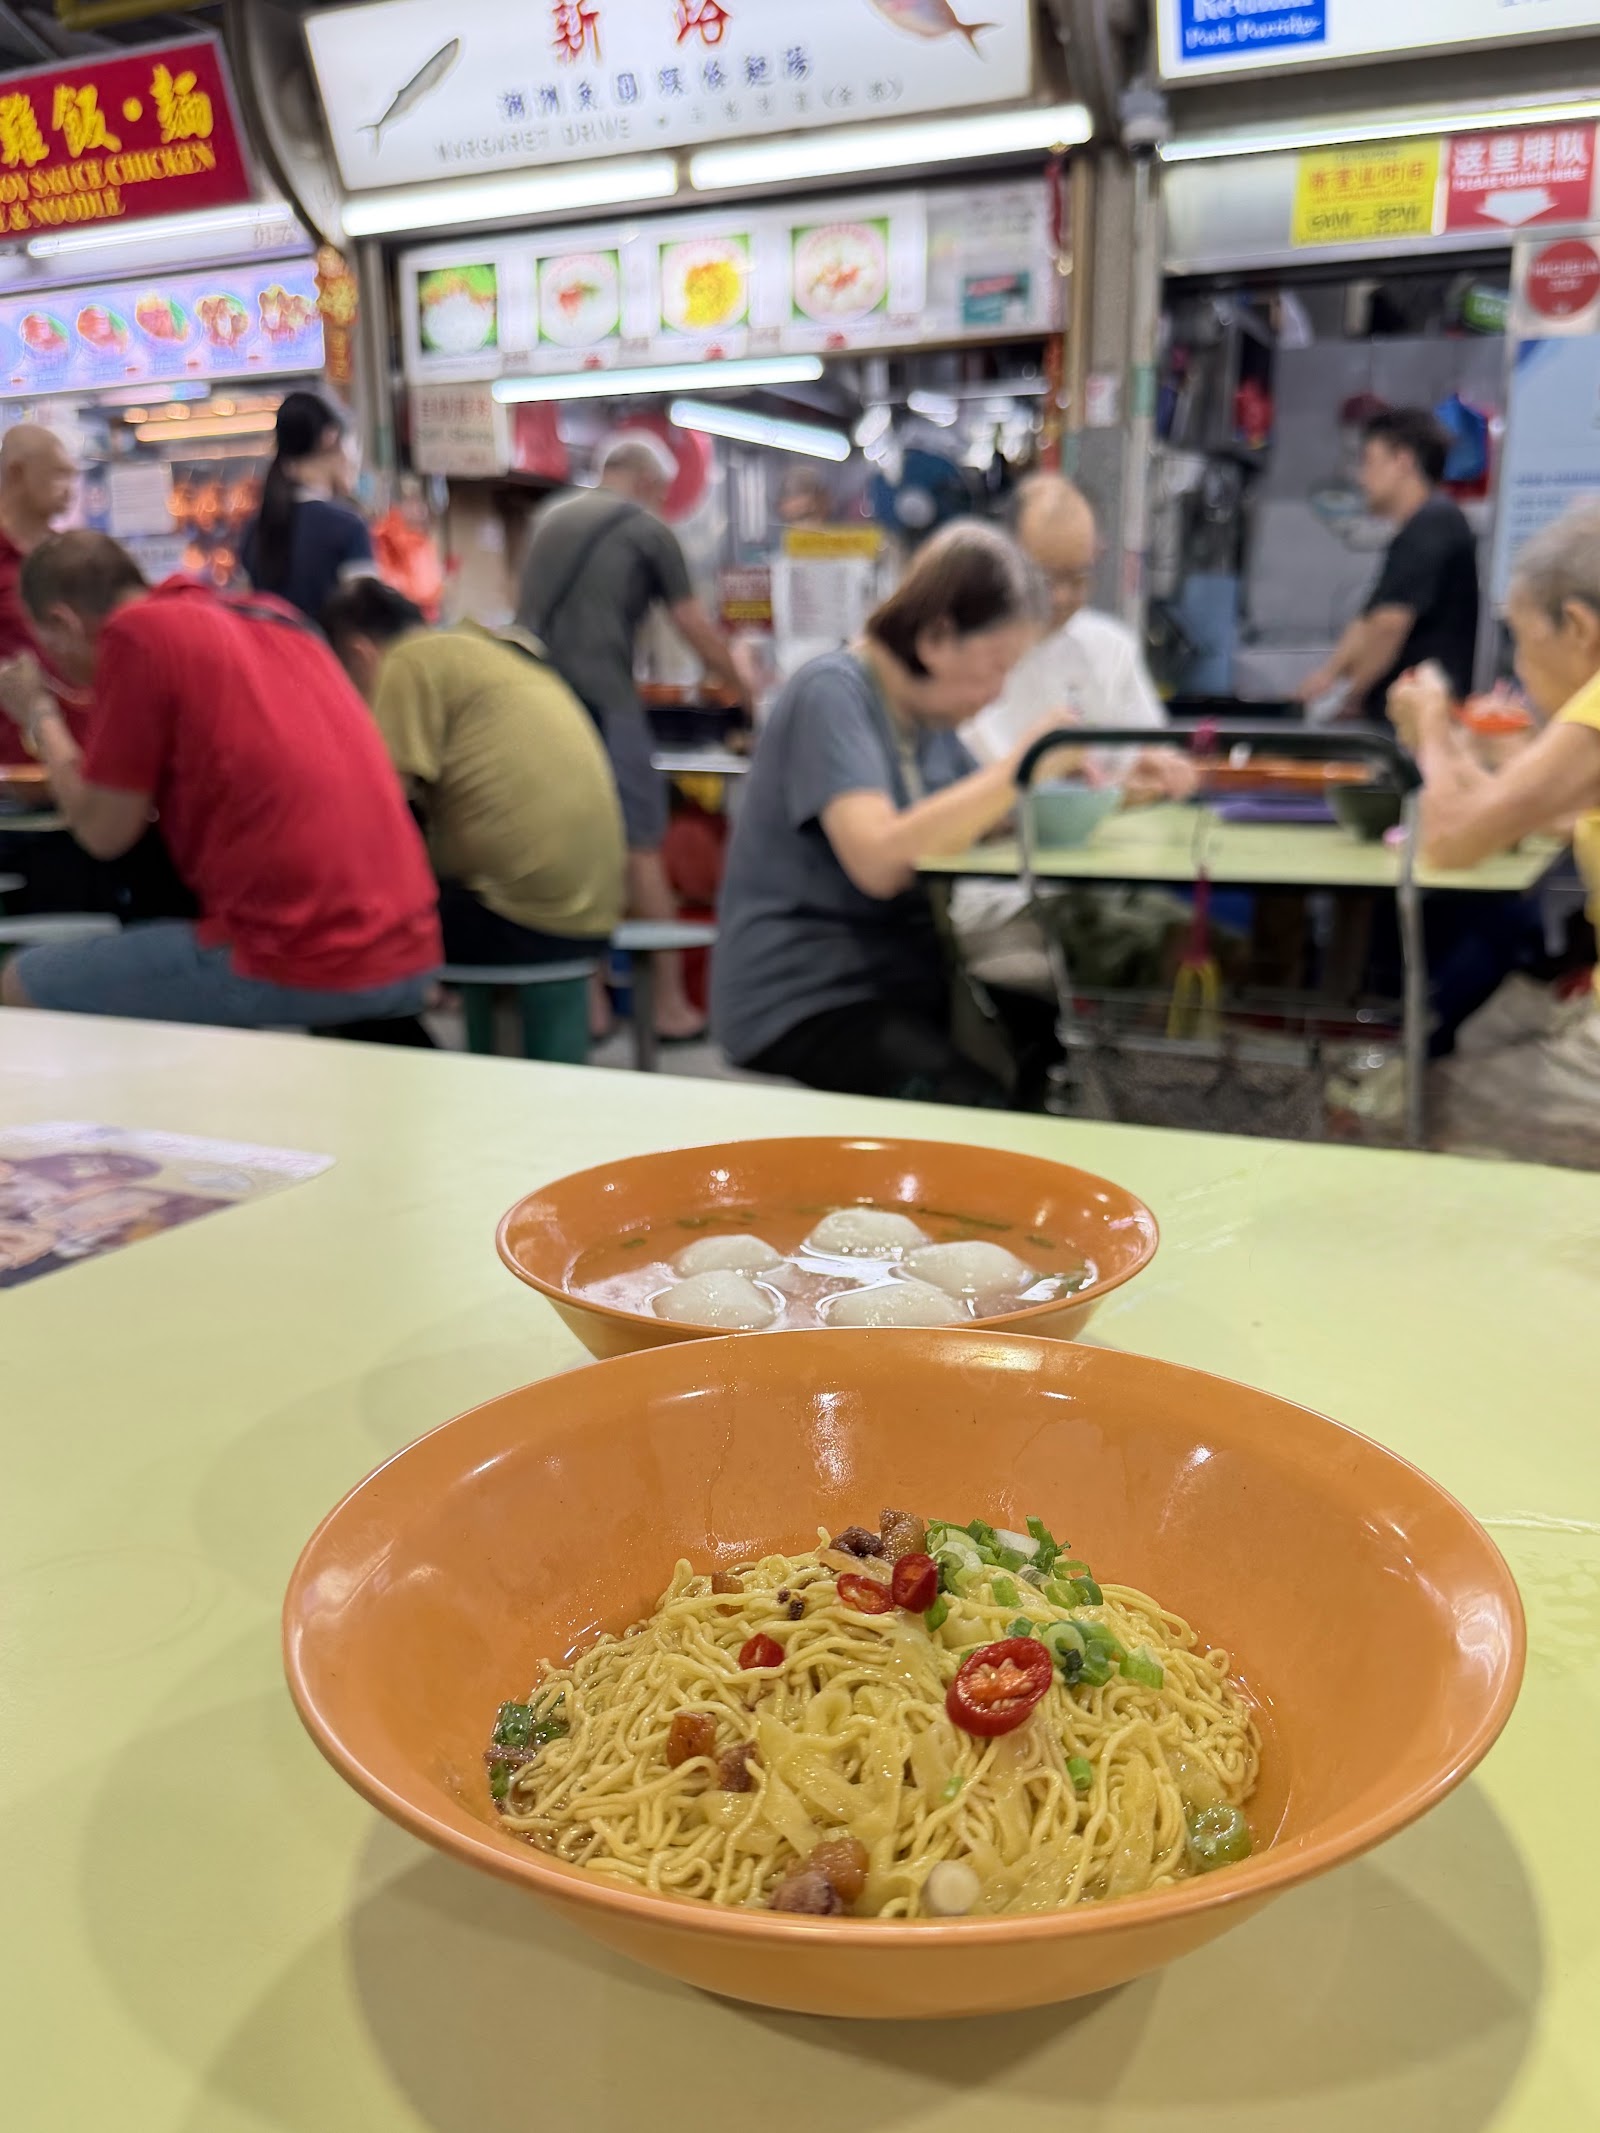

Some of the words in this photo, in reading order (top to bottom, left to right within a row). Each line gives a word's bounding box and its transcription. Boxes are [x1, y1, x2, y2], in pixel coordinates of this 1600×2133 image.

[104, 139, 216, 186] CHICKEN
[1453, 130, 1590, 176] 这里排队
[28, 186, 126, 227] NOODLE
